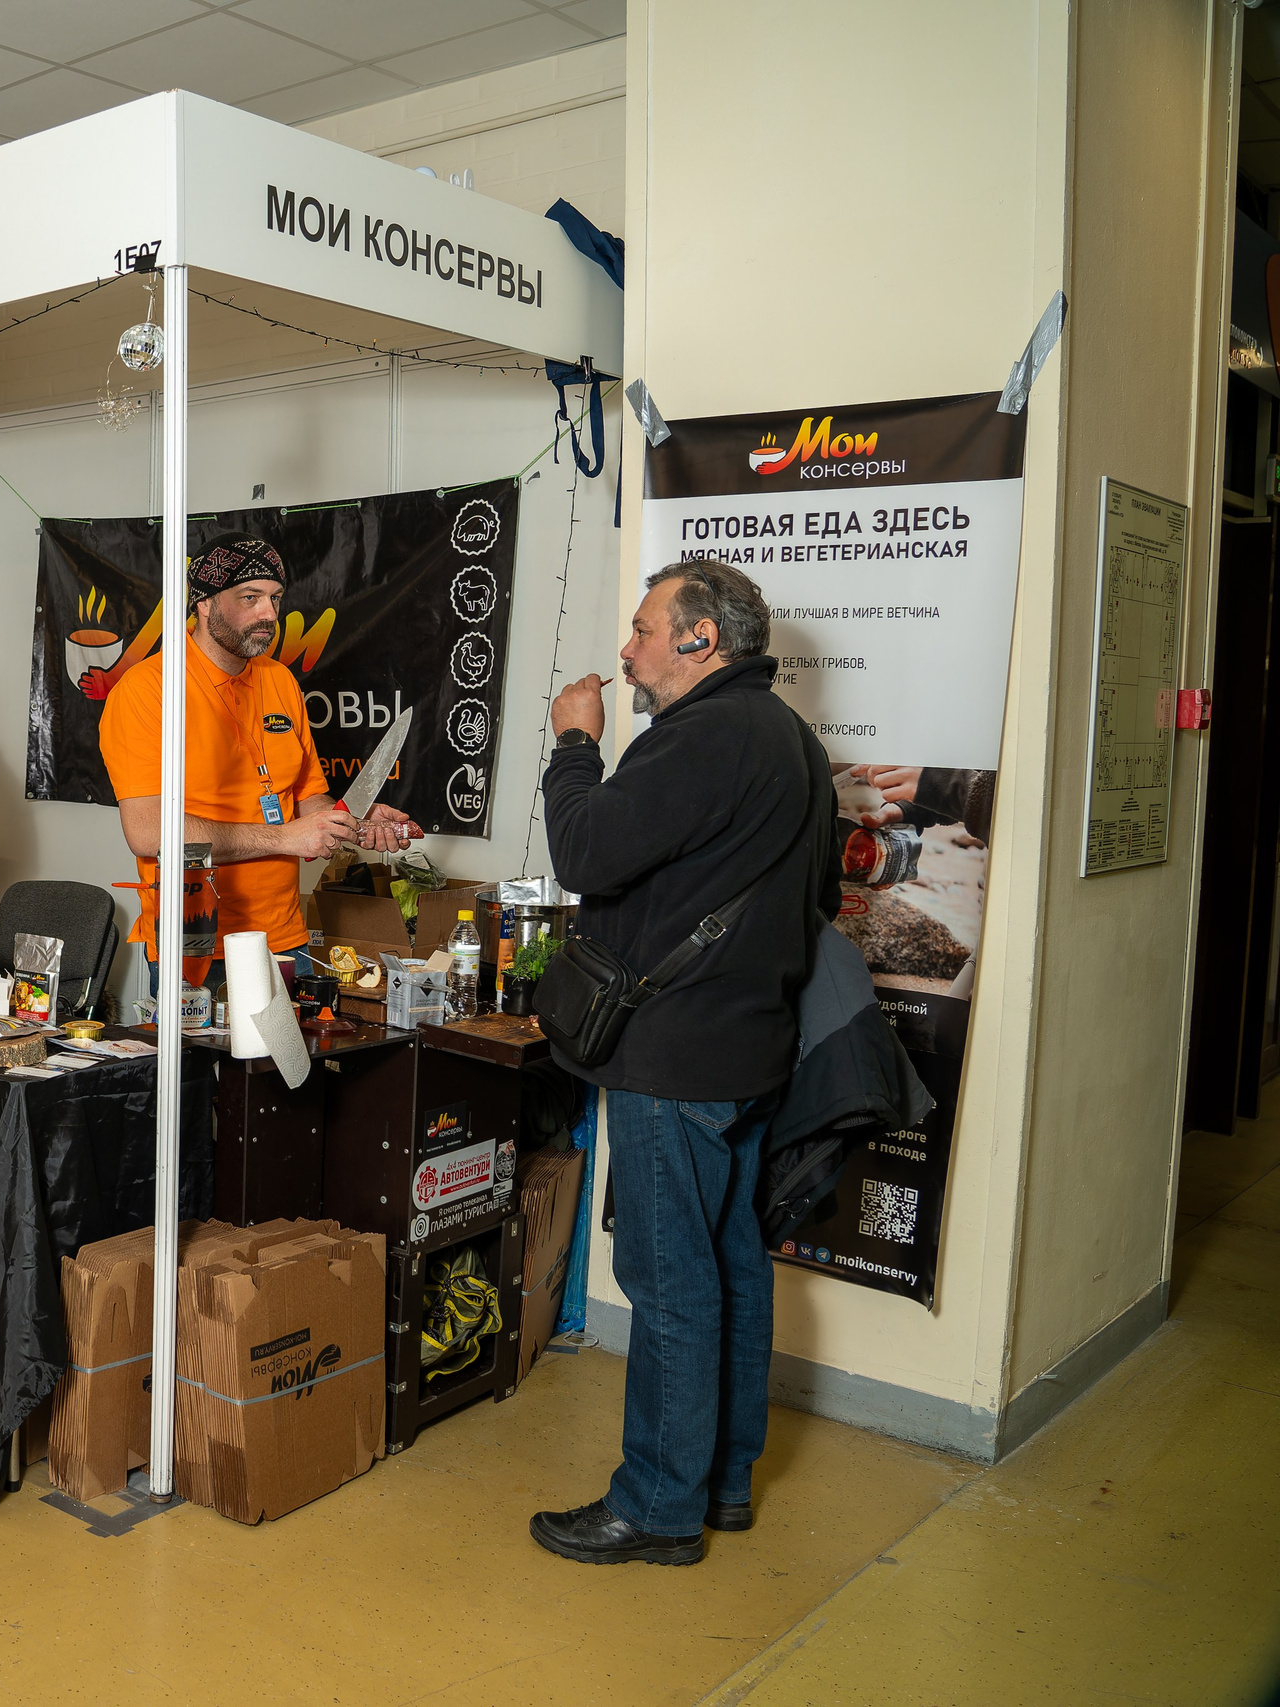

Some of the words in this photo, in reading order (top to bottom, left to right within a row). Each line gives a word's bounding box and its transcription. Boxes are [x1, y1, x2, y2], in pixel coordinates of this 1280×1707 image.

[266, 184, 350, 252] МОИ
[364, 214, 542, 309] КОНСЕРВЫ
[787, 416, 878, 462] Мои
[800, 460, 906, 479] консервы
[682, 514, 794, 540] ГОТОВАЯ
[804, 511, 862, 539] ЕДА
[872, 506, 970, 537] ЗДЕСЬ
[762, 546, 774, 563] И
[780, 540, 968, 562] ВЕГЕТЕРИАНСКАЯ
[793, 608, 838, 620] ЛУЧШАЯ
[842, 608, 849, 618] В
[852, 606, 884, 618] МИРЕ
[886, 606, 940, 618] ВЕТЧИНА
[782, 657, 820, 668] БЕЛЫХ
[822, 657, 867, 670] ГРИБОВ,
[820, 723, 876, 736] ВКУСНОГО
[453, 794, 481, 809] VEG
[878, 1000, 928, 1015] добной
[438, 1112, 458, 1131] Мои
[868, 1142, 876, 1150] в
[880, 1143, 927, 1162] походе
[430, 1212, 462, 1233] ГЛАЗАМИ
[464, 1200, 494, 1220] ТУРИСТА
[835, 1252, 918, 1286] moikonservy
[254, 1332, 308, 1357] MOI-KONSERVY.RU
[250, 1347, 312, 1378] консервы
